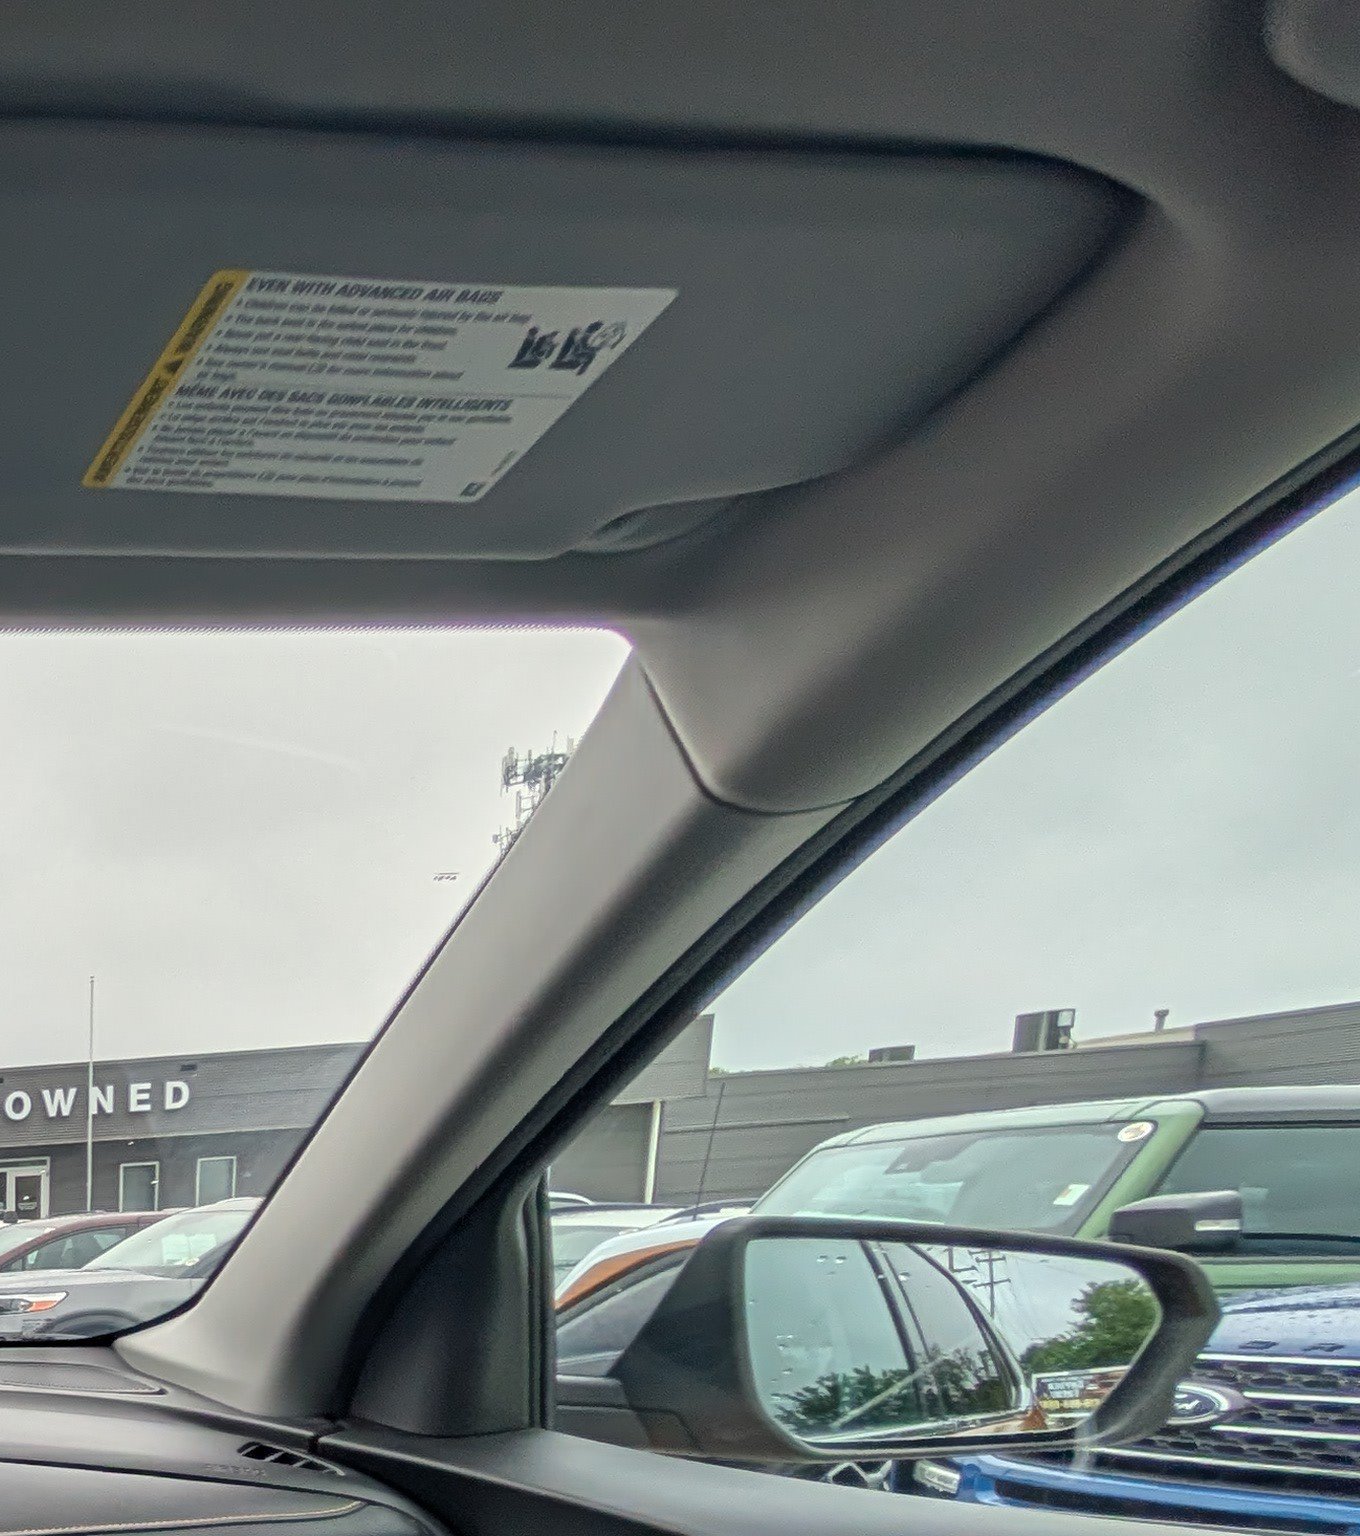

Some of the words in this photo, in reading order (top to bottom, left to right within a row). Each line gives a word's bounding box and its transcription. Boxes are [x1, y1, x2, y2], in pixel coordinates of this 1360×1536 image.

[245, 277, 291, 293] EVEN
[291, 279, 338, 296] WITH
[335, 283, 425, 300] ADVANCED
[423, 287, 457, 303] AIR
[454, 288, 505, 305] BAGS
